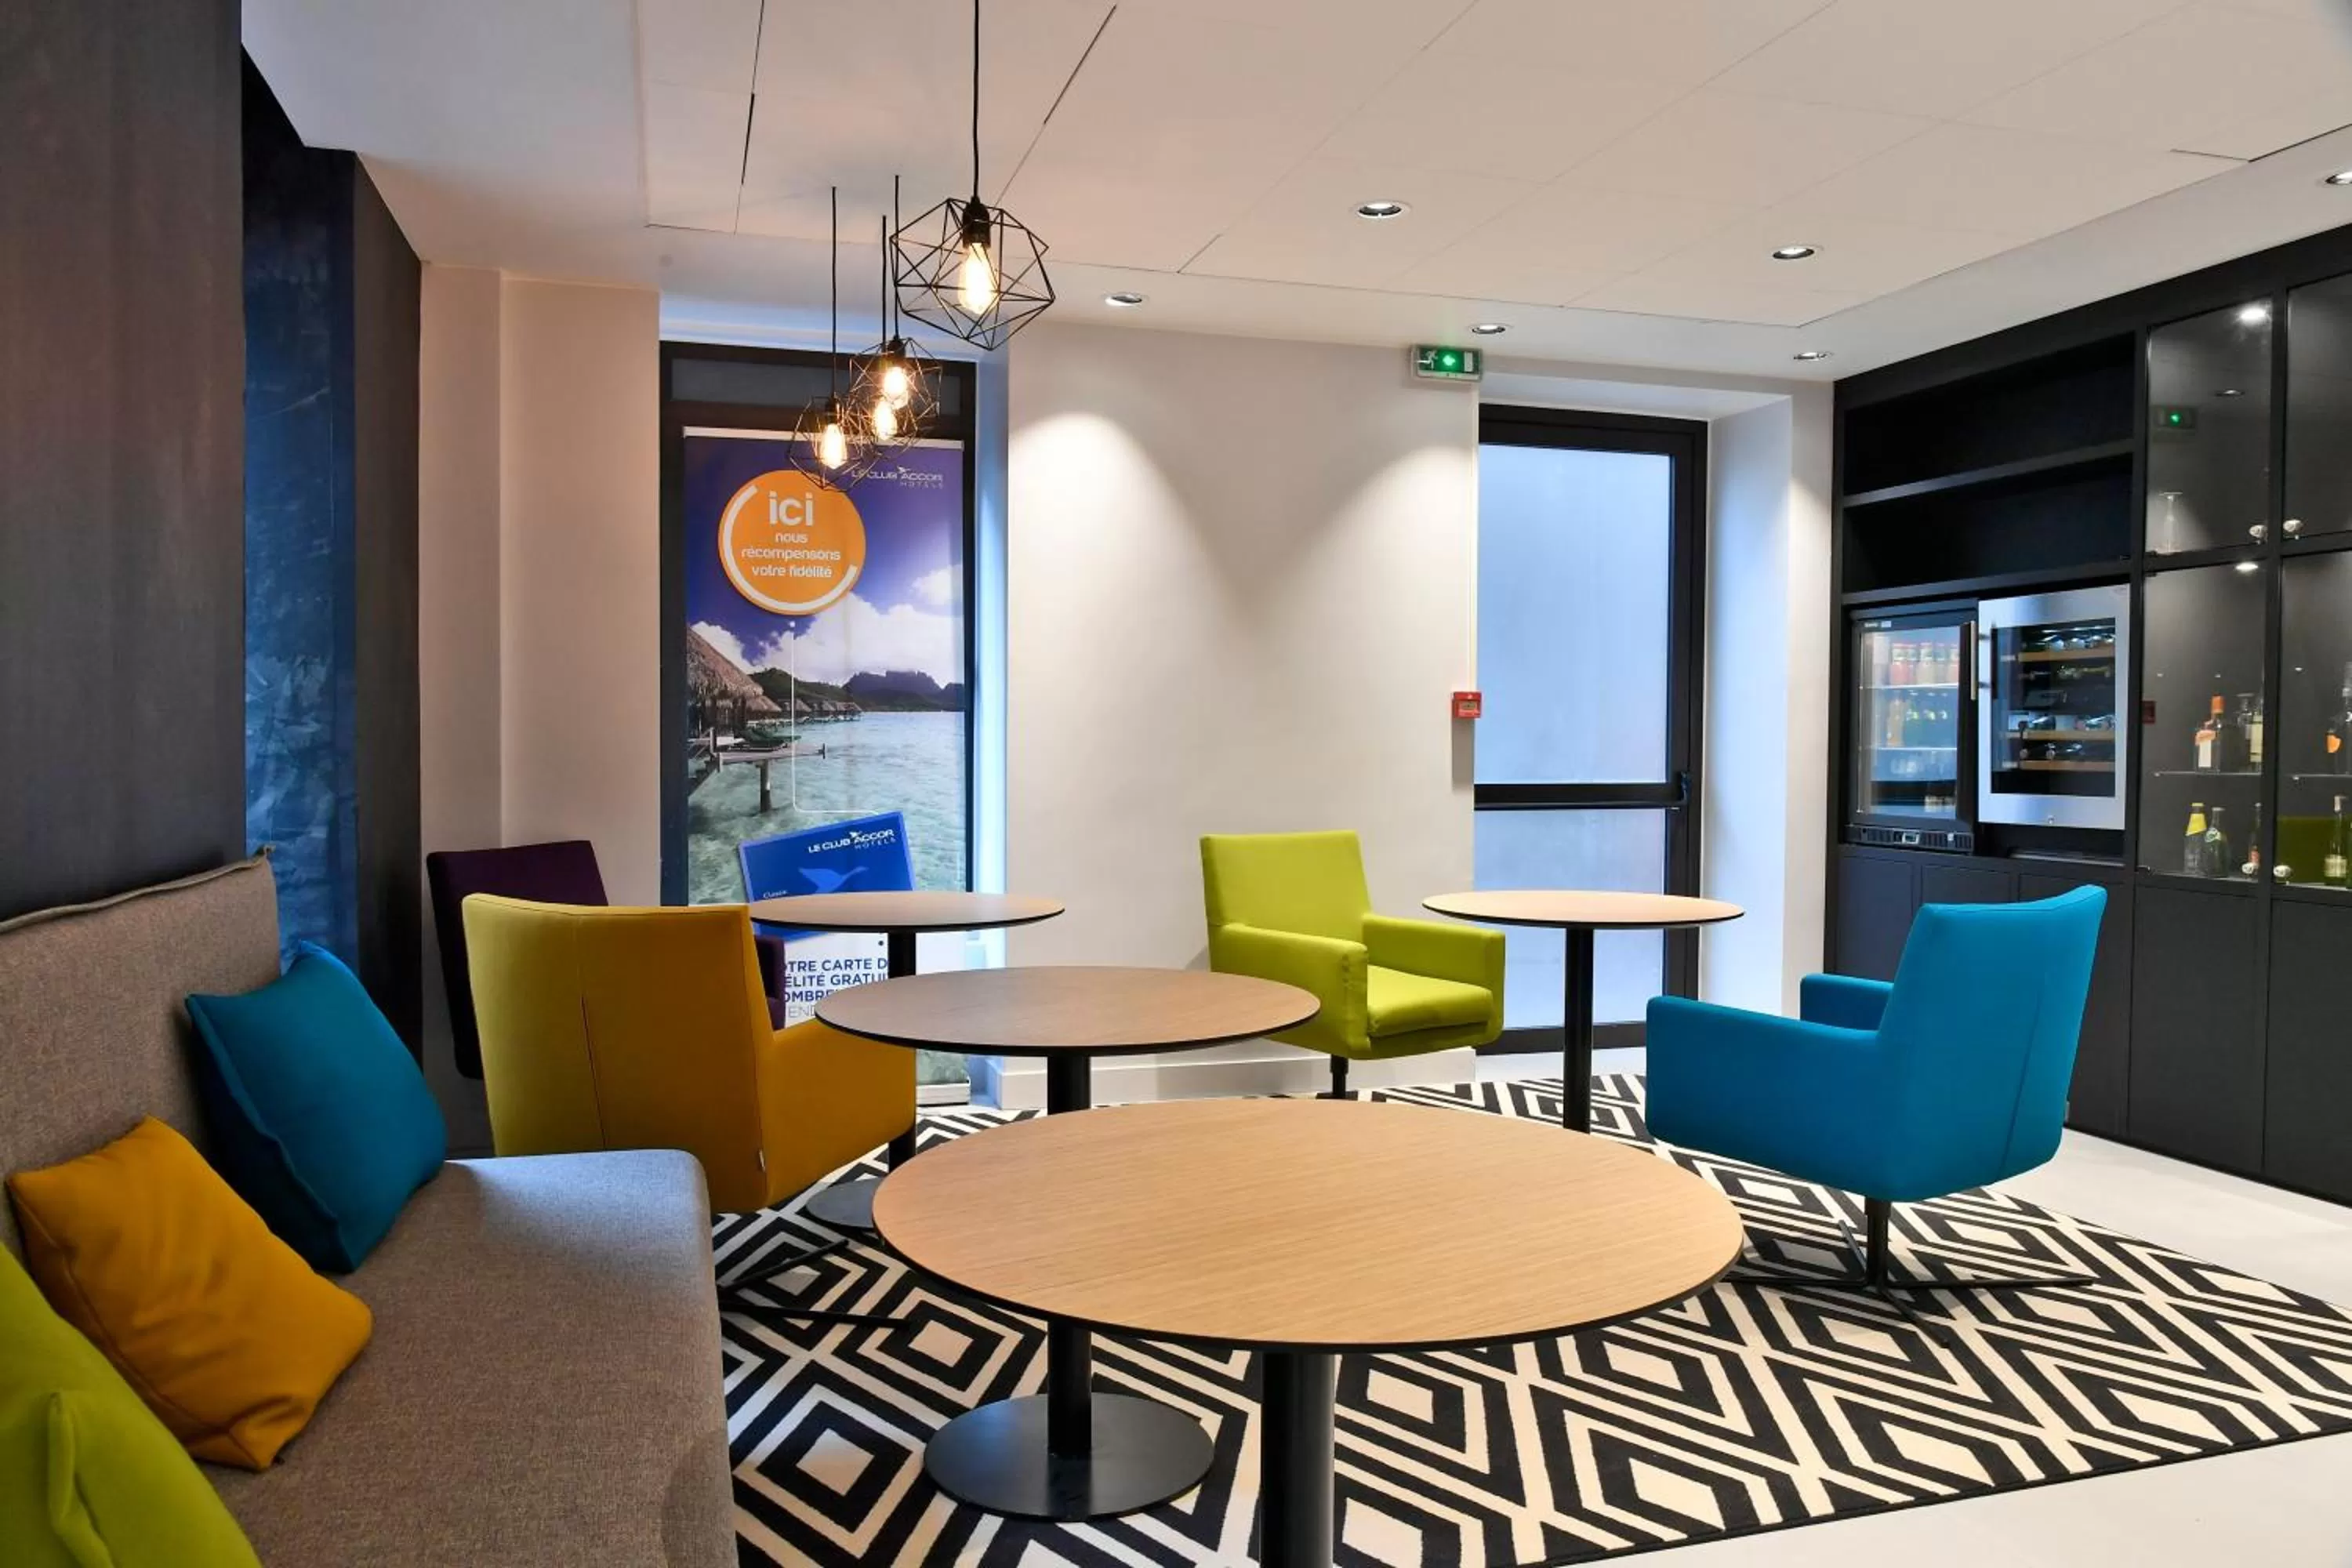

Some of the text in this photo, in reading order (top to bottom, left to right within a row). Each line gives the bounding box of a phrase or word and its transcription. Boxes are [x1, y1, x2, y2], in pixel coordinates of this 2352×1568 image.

[900, 472, 943, 481] ACCOR
[768, 490, 814, 527] ici
[775, 532, 809, 543] nous
[741, 546, 841, 562] récompensons
[752, 564, 833, 579] votre fidélité
[808, 829, 895, 854] LE CLUB ACCOR
[784, 960, 817, 973] TRE
[821, 958, 873, 971] CARTE
[784, 972, 886, 988] ÉLITÉ GRATUI
